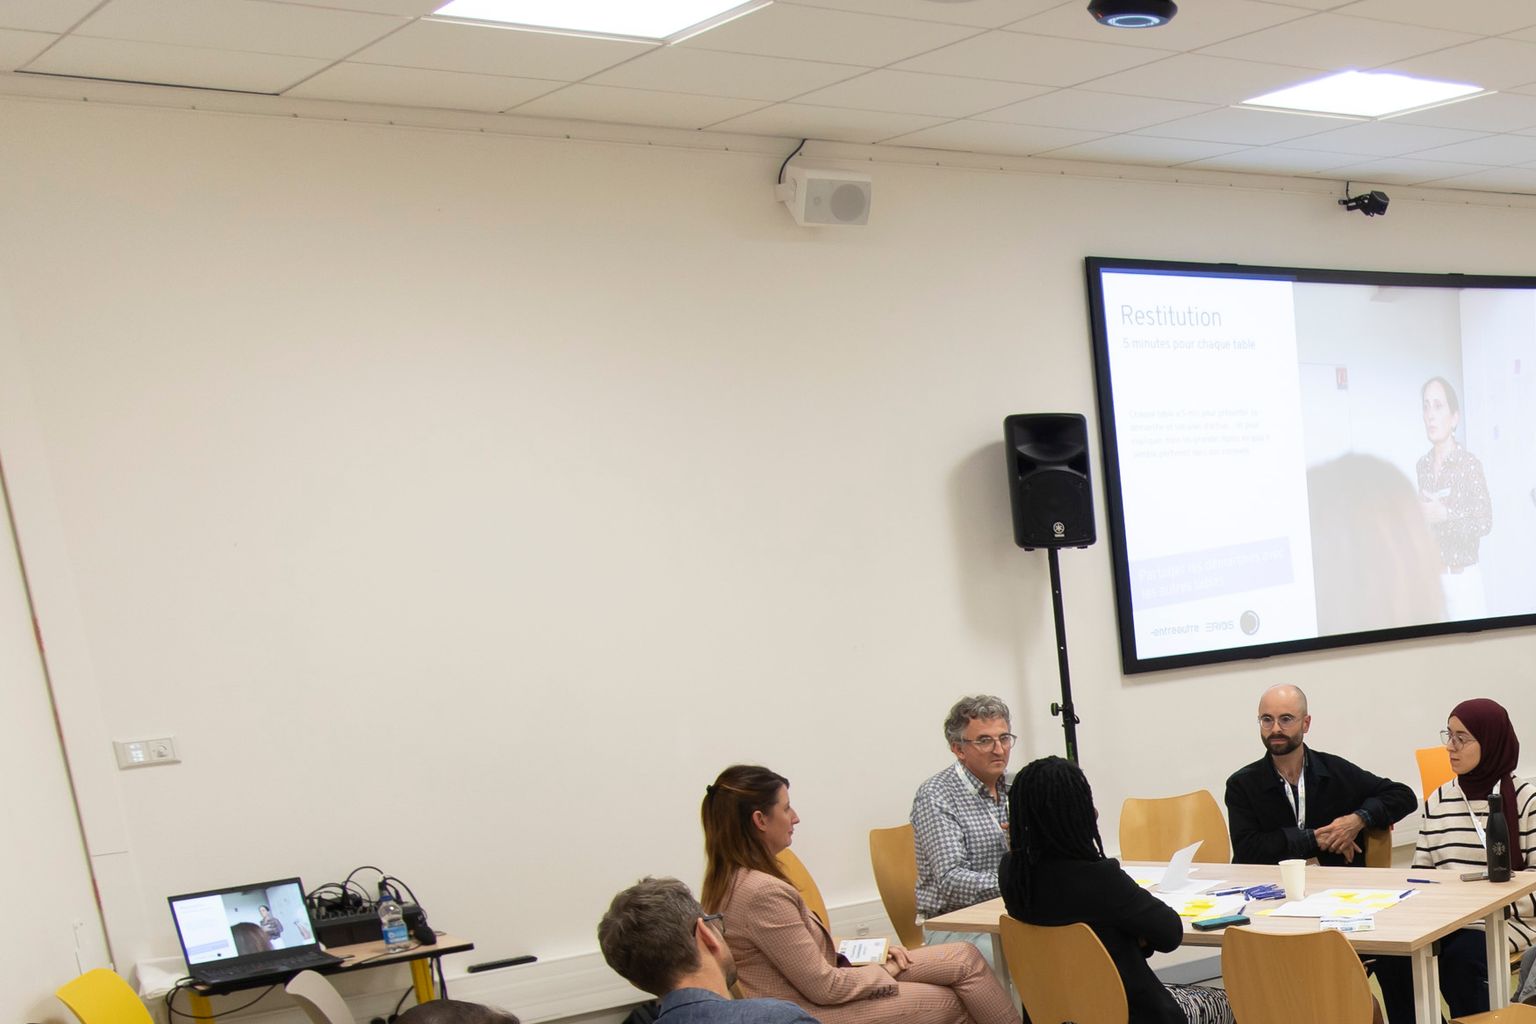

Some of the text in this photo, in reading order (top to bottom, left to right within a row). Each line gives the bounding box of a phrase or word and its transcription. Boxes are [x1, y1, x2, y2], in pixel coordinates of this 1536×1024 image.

[1120, 304, 1222, 328] Restitution
[1122, 337, 1256, 352] 5 minutes pour chaque table
